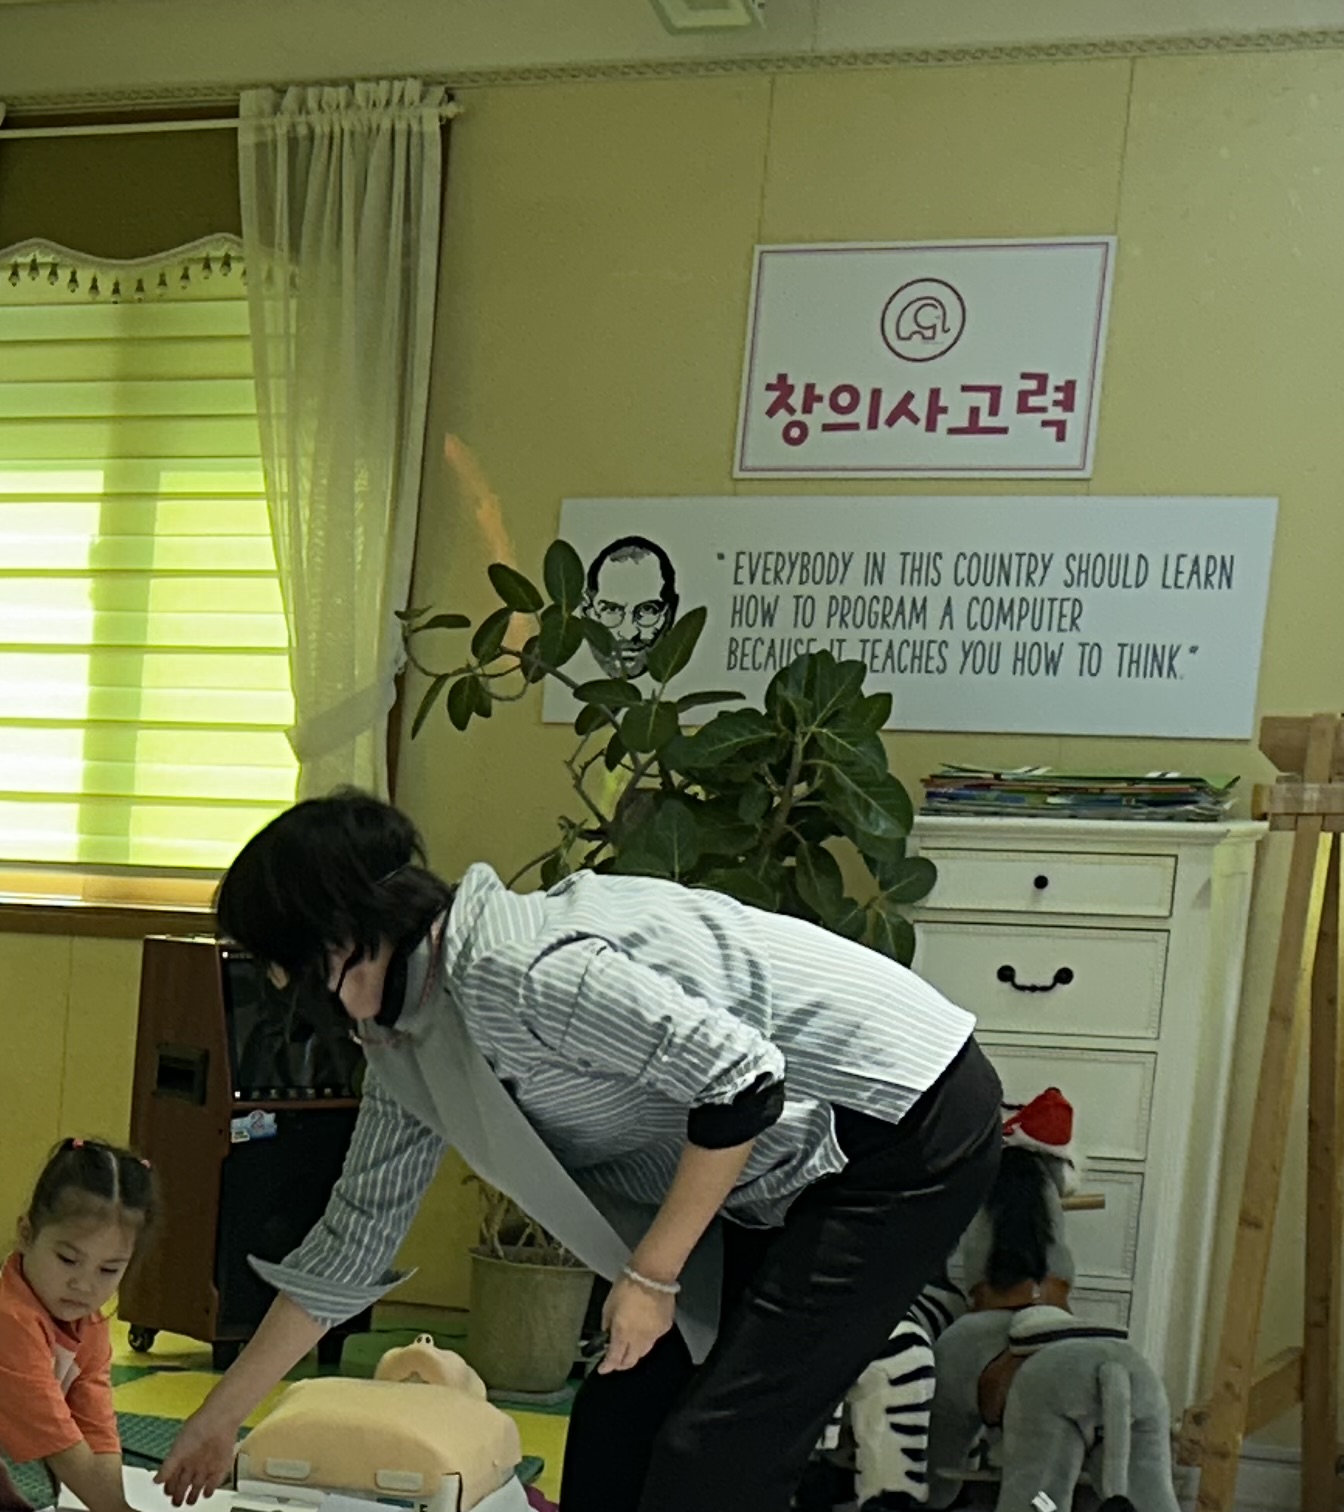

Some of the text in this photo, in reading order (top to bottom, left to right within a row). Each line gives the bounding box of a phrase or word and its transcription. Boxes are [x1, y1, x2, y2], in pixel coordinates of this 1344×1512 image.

[764, 372, 1078, 447] 창의사고력
[863, 551, 887, 587] IN
[899, 551, 943, 588] THIS
[953, 551, 1054, 588] COUNTRY
[1063, 552, 1149, 590] SHOULD
[1160, 553, 1235, 591] LEARN
[730, 594, 1084, 633] HOW TO PROGRAM A COMPUTER
[859, 638, 949, 674] TEACHES
[958, 640, 1002, 676] YOU
[1012, 641, 1065, 678] HOW
[1077, 641, 1103, 678] TO
